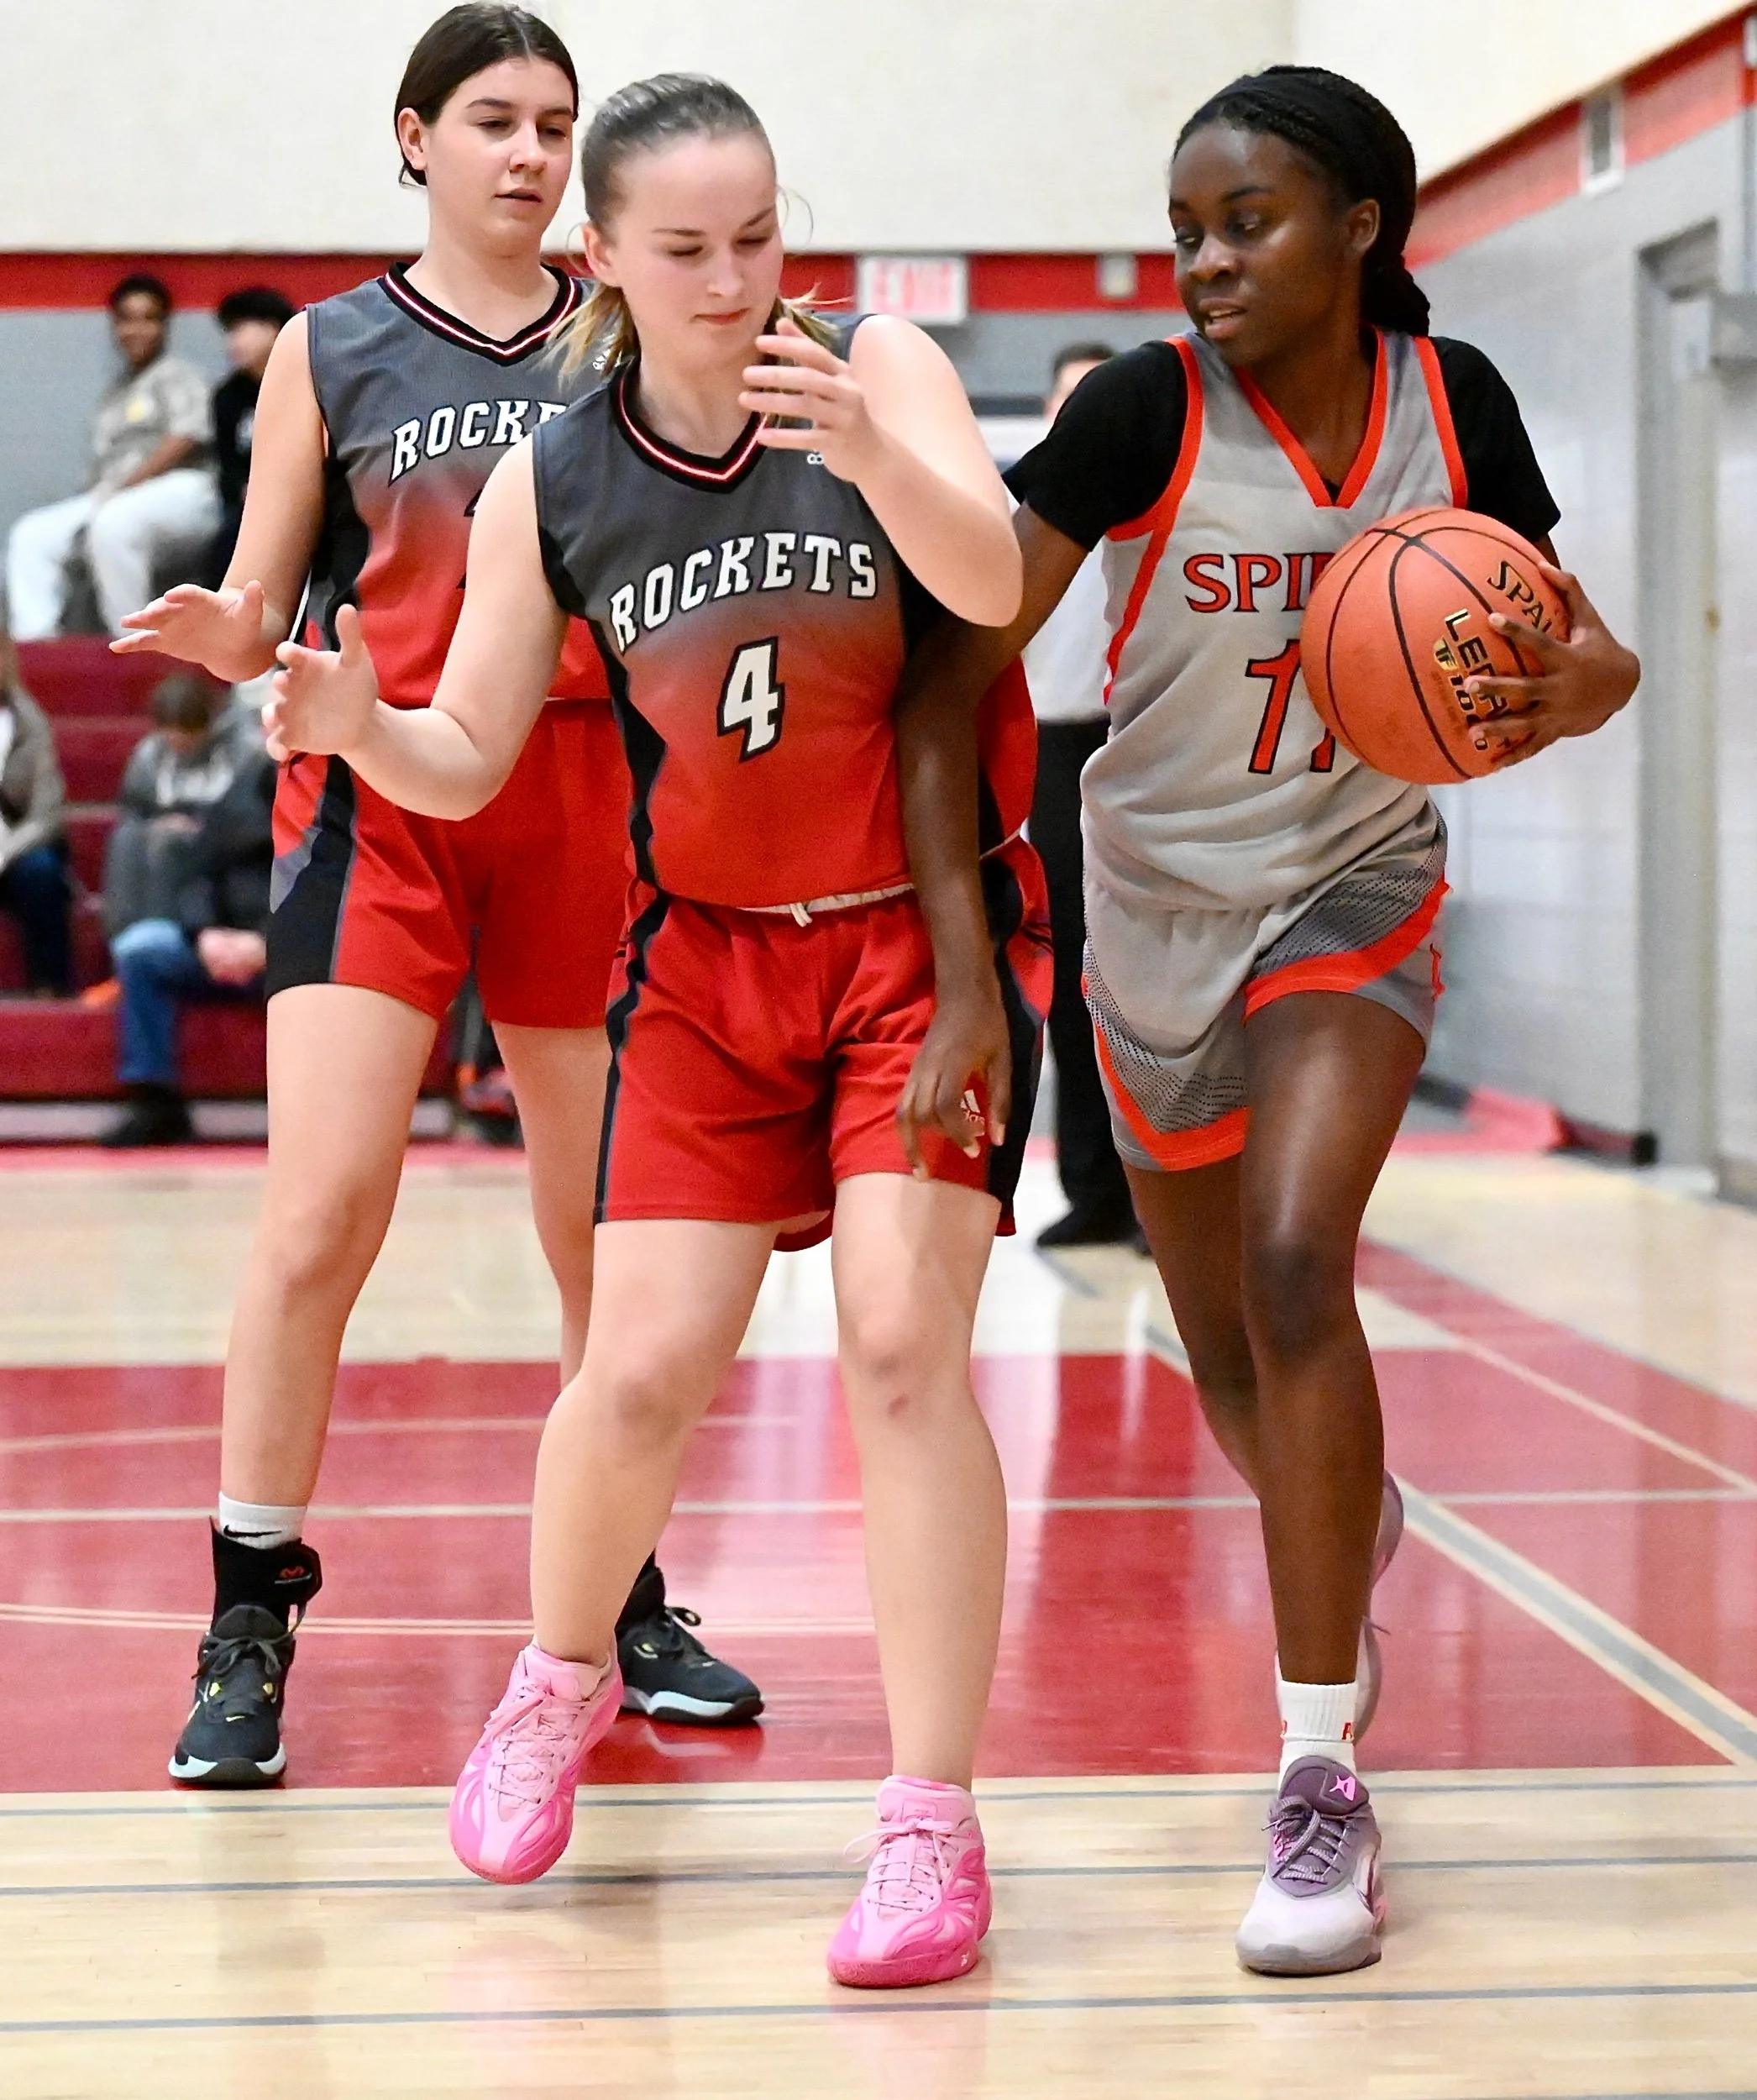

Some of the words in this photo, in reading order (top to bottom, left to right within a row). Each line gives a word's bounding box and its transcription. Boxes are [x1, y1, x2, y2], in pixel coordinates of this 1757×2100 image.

[609, 530, 879, 657] ROCKETS
[716, 636, 785, 764] 4
[1244, 638, 1336, 775] 1
